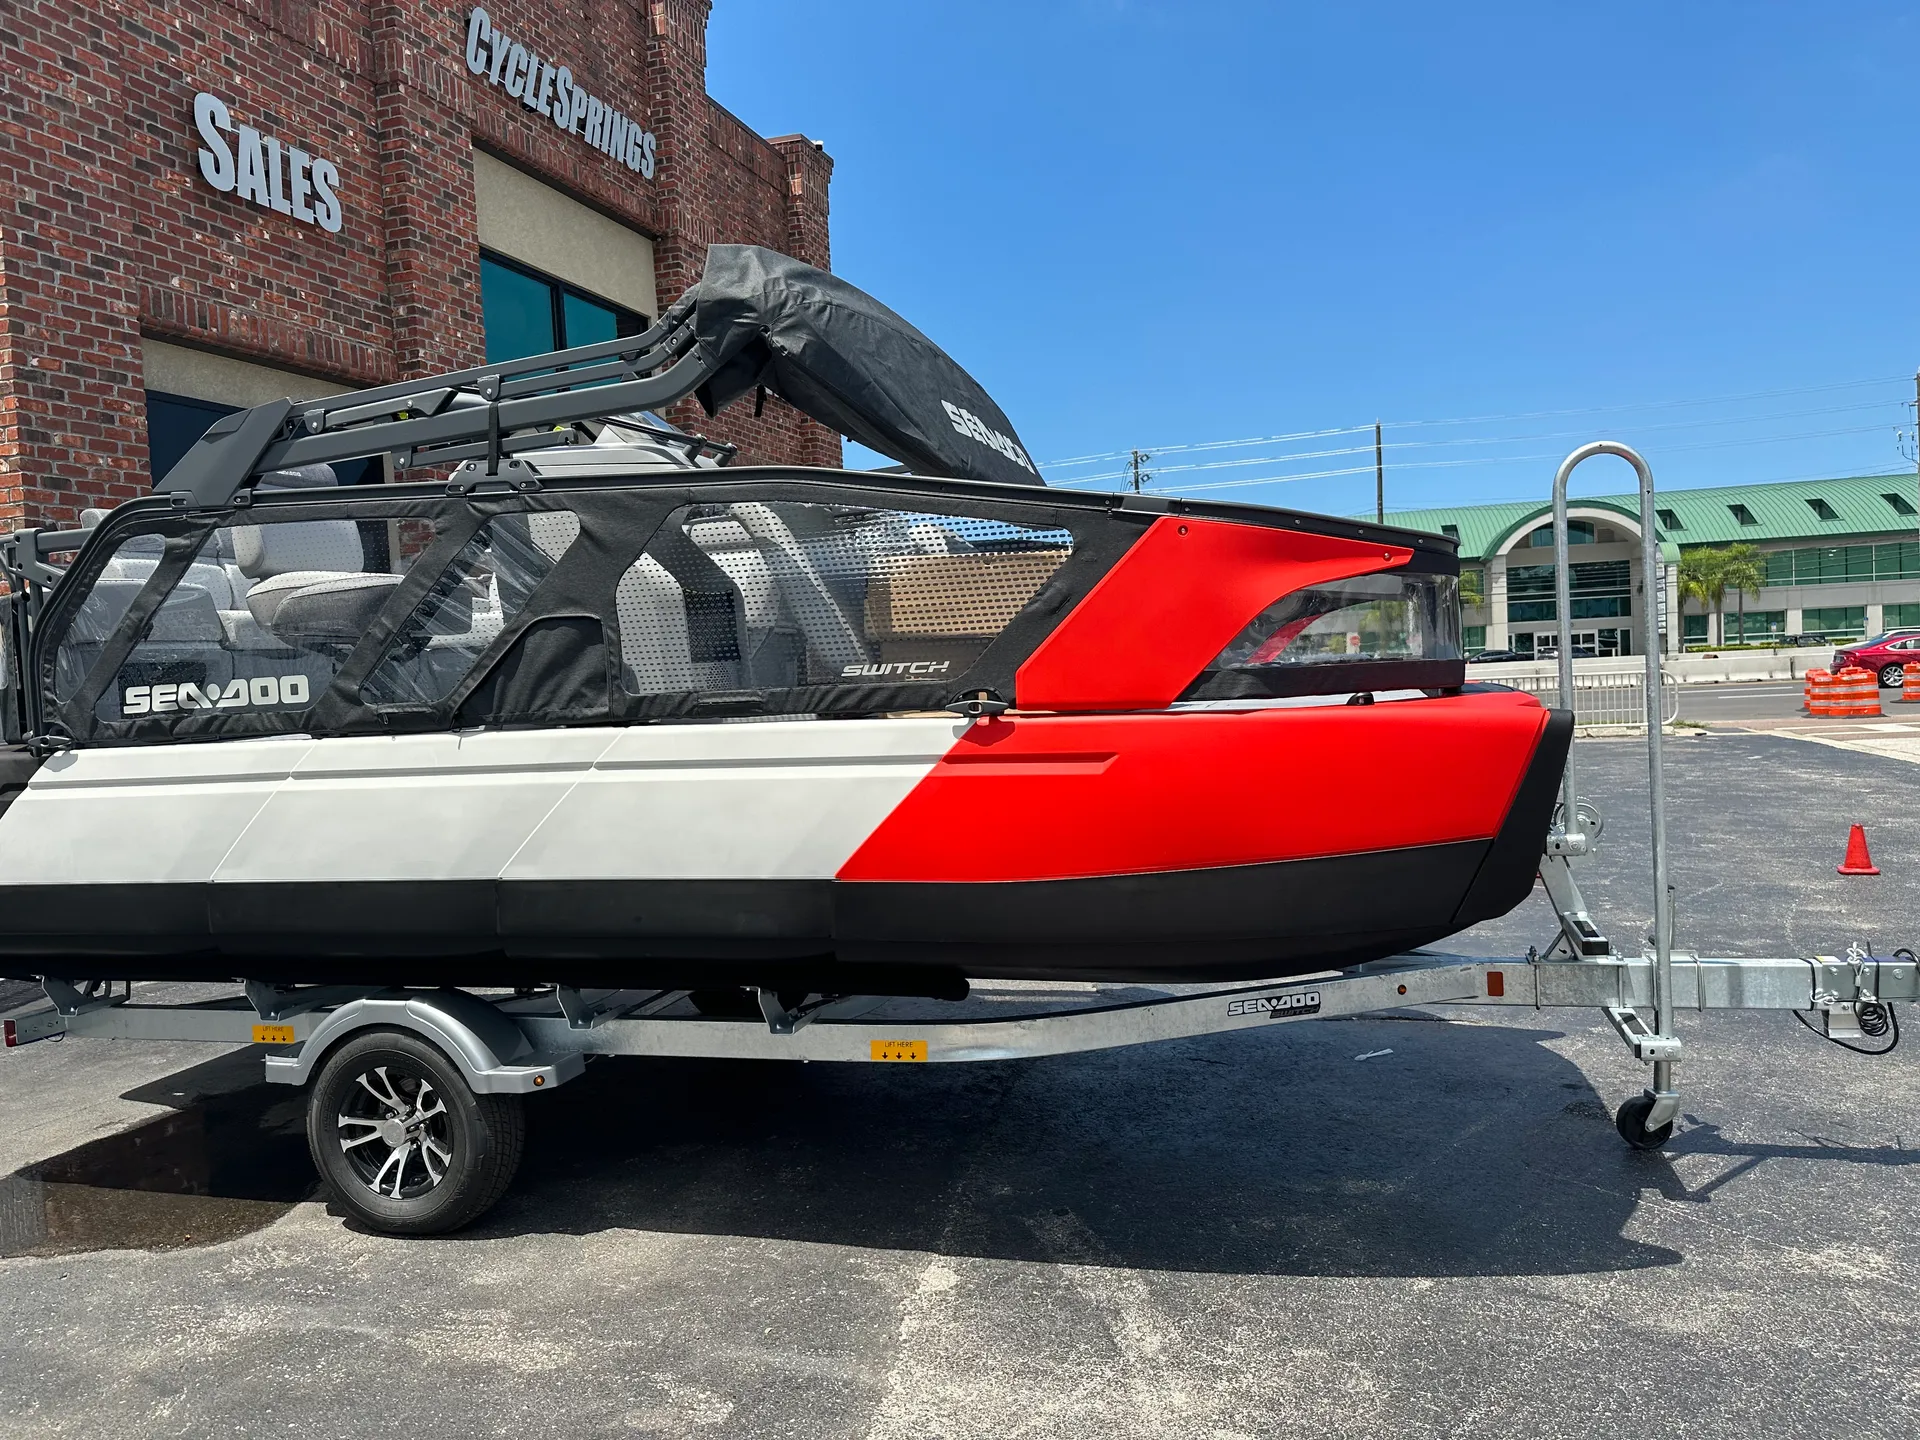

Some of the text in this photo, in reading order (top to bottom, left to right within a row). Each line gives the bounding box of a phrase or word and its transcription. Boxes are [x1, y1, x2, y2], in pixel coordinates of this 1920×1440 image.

[466, 7, 656, 179] CYCLESPRINGS
[194, 92, 342, 233] SALES
[841, 661, 950, 676] SWITCH
[1270, 1006, 1318, 1018] SWITCH
